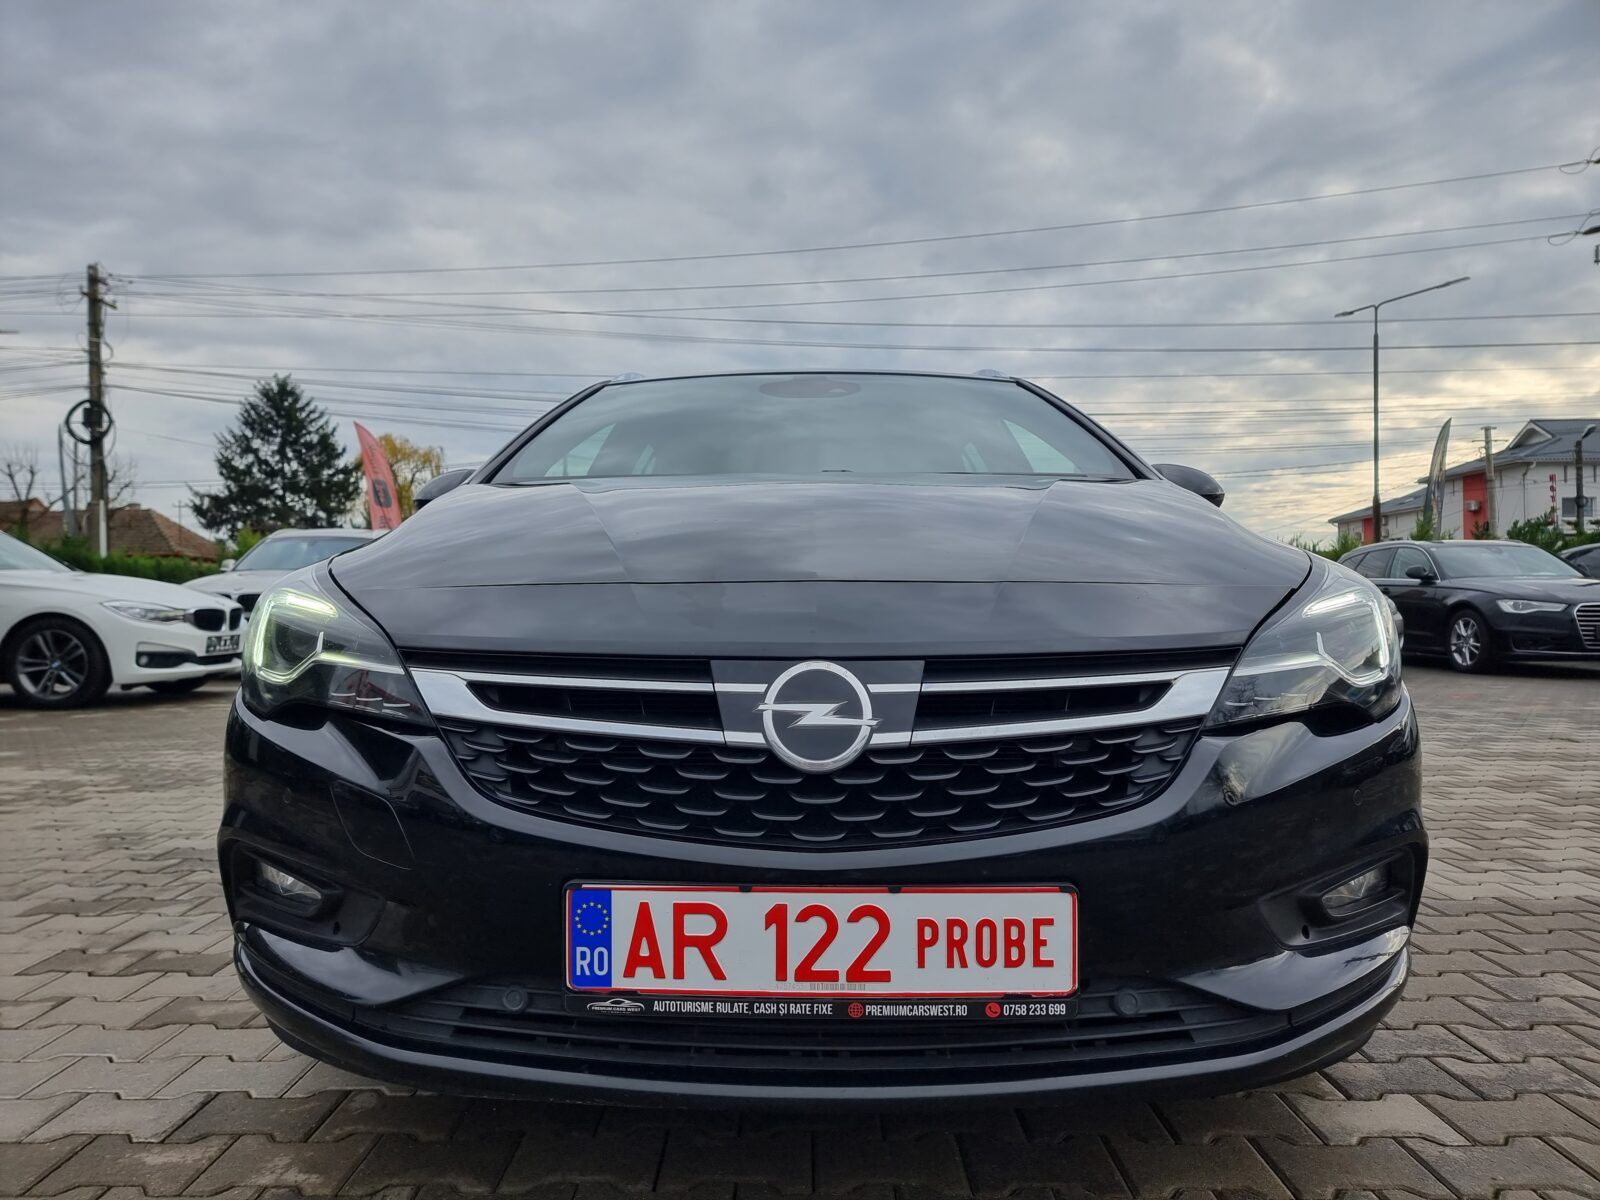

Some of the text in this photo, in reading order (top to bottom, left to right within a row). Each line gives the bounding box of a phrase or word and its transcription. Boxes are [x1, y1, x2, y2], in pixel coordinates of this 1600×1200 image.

[623, 902, 1055, 983] AR 122 PROBE
[575, 946, 609, 976] RO
[653, 1000, 714, 1013] AUTOTURISME
[716, 1002, 752, 1015] RULATE,
[753, 1003, 777, 1014] CASH
[789, 1003, 812, 1015] RATE
[813, 1003, 833, 1015] FIXE
[865, 1004, 968, 1016] PREMIUMCARSWEST.RO
[1003, 1003, 1066, 1016] 0758 233 699
